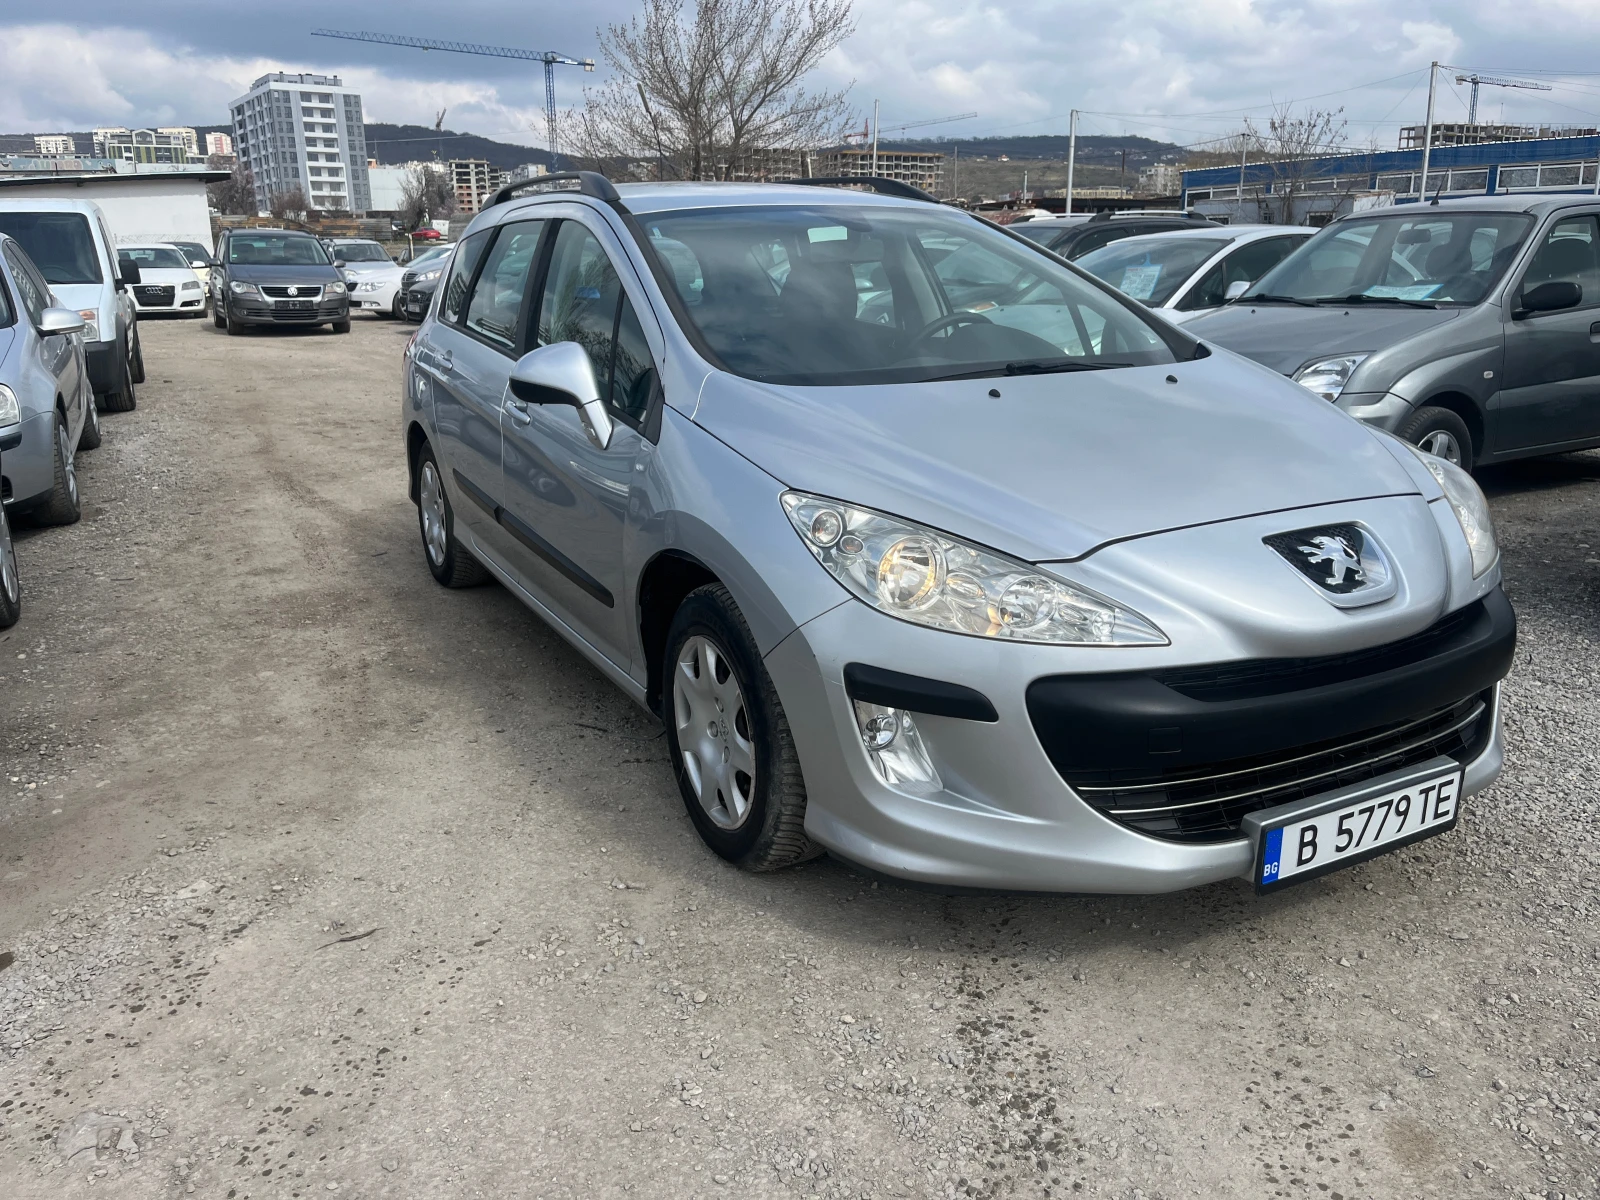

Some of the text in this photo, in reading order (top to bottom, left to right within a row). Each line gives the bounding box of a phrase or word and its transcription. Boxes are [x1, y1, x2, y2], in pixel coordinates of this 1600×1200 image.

[1297, 778, 1455, 867] B 5779 TE
[1263, 861, 1279, 877] BG
